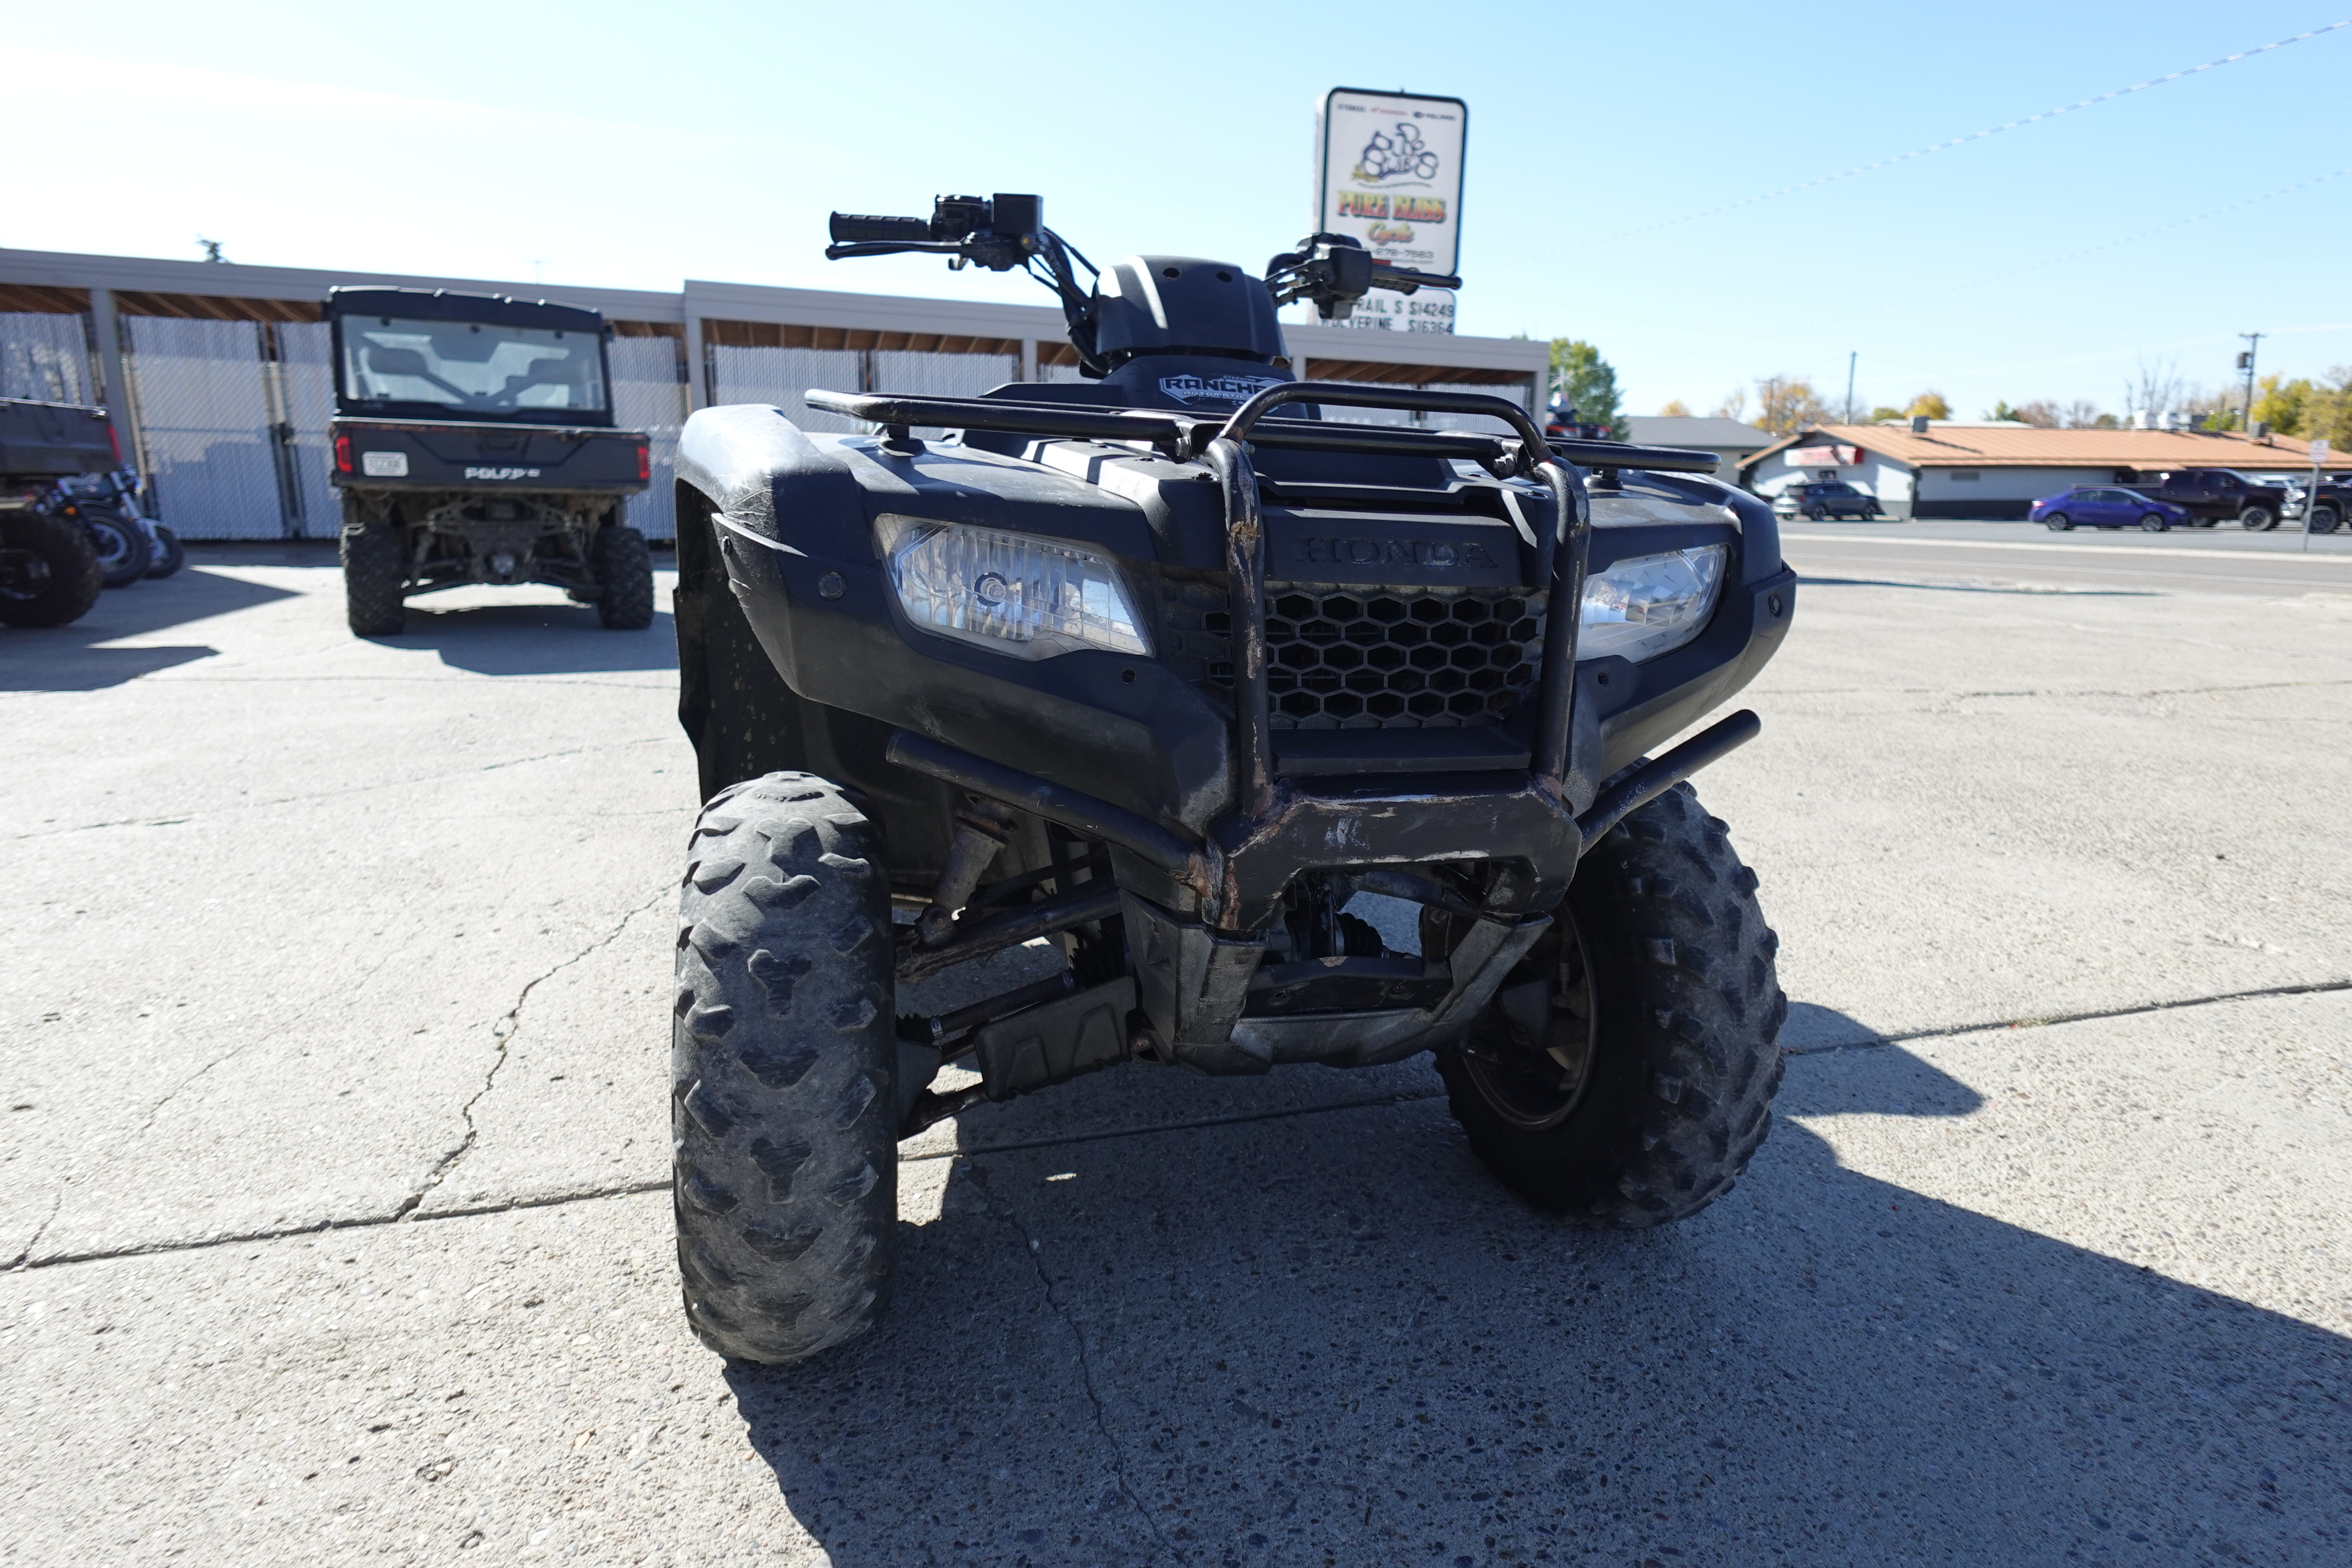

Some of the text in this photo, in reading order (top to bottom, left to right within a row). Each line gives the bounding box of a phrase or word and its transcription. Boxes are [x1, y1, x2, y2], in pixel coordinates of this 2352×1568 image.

[1338, 190, 1446, 223] PURE BLISS
[1357, 298, 1387, 313] RAIL
[1394, 300, 1403, 314] S
[1165, 378, 1269, 394] RANCHE
[1183, 391, 1246, 399] AUTOMATIC
[1295, 537, 1499, 568] HONDA
